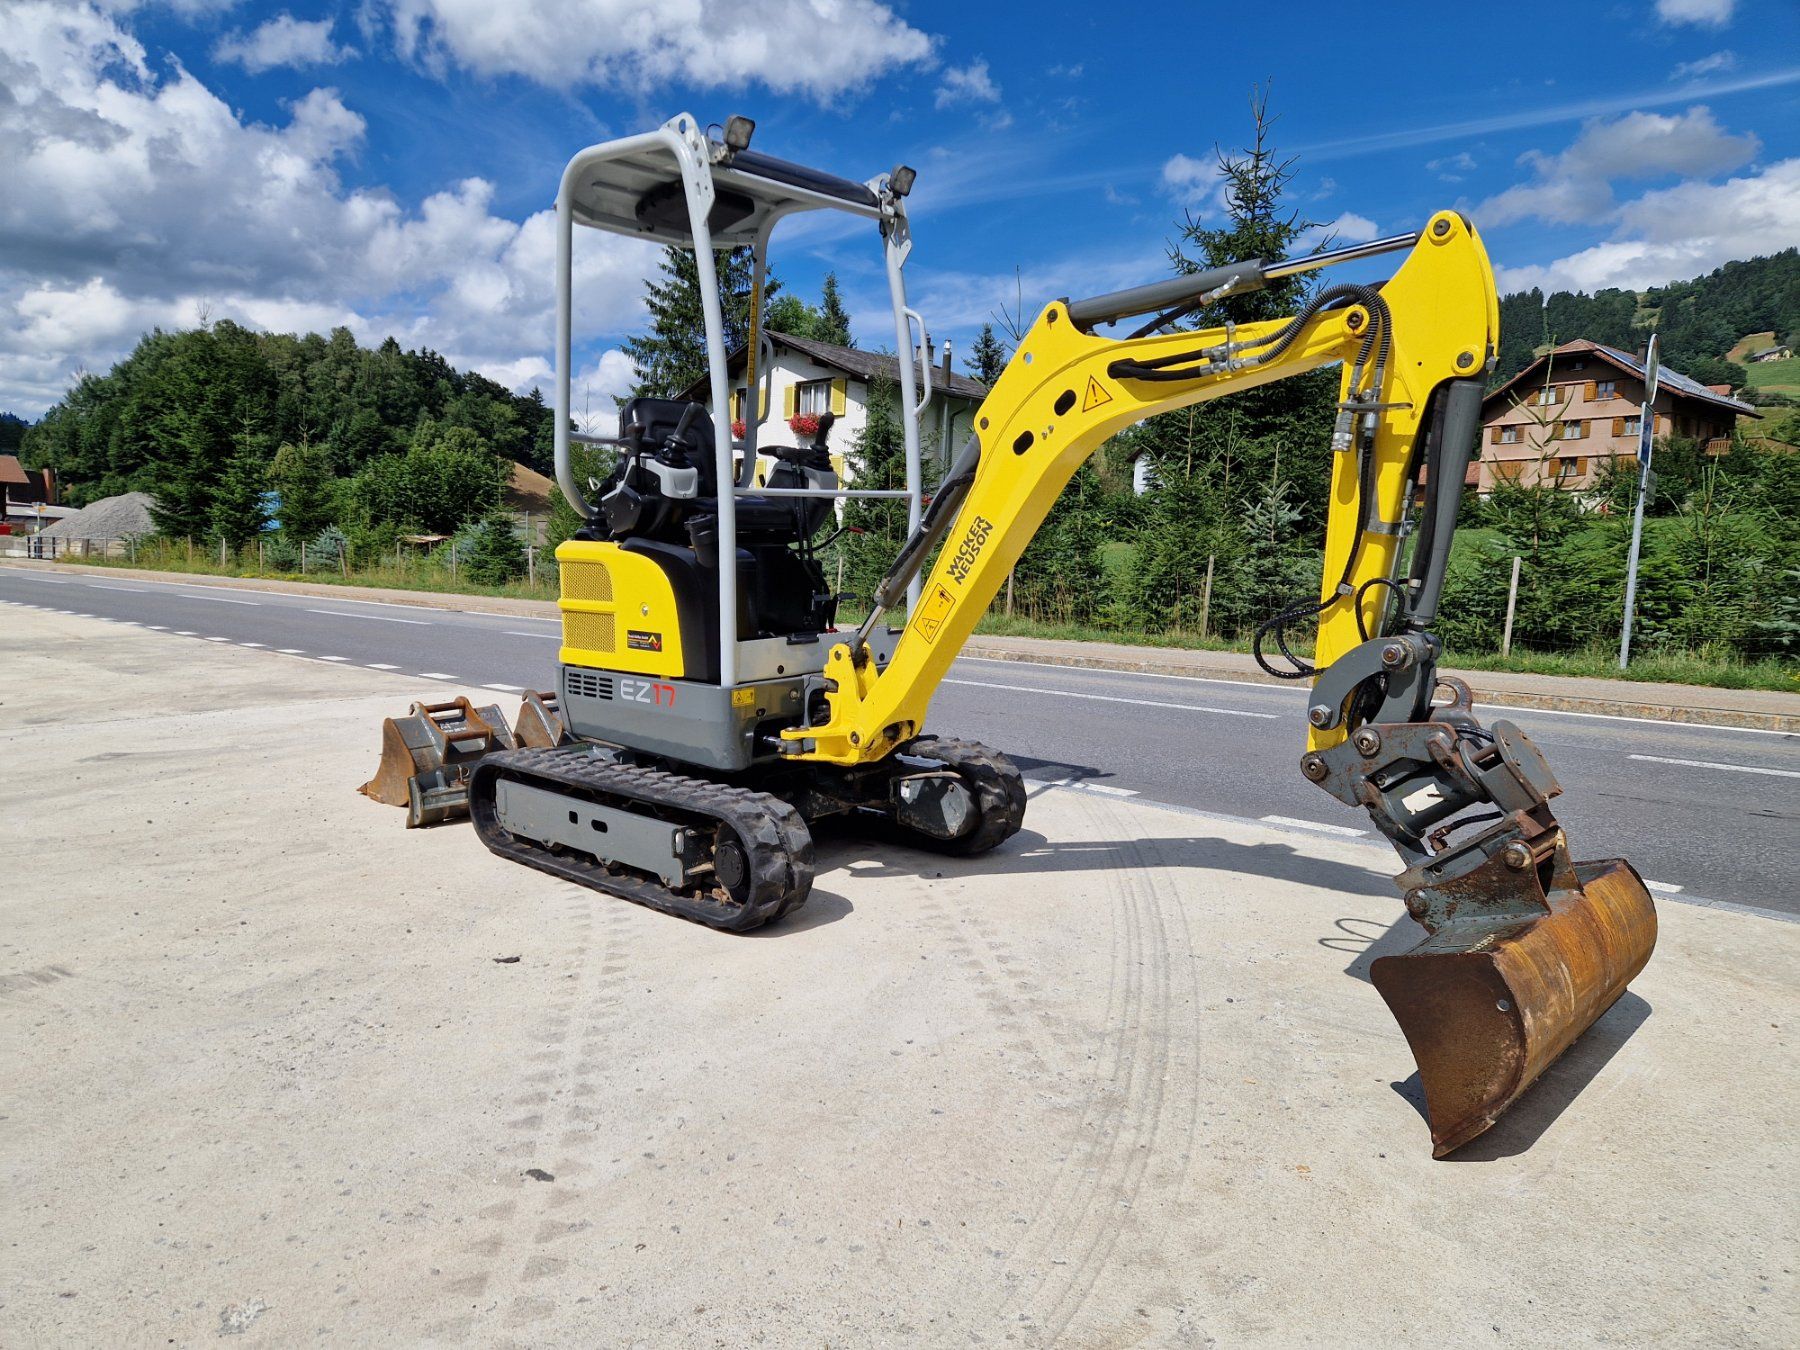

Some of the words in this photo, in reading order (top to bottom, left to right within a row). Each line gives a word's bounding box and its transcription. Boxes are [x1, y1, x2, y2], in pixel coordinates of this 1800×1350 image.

[946, 516, 985, 575] WACKER
[954, 521, 993, 585] NEUSON
[621, 679, 675, 707] EZ17
